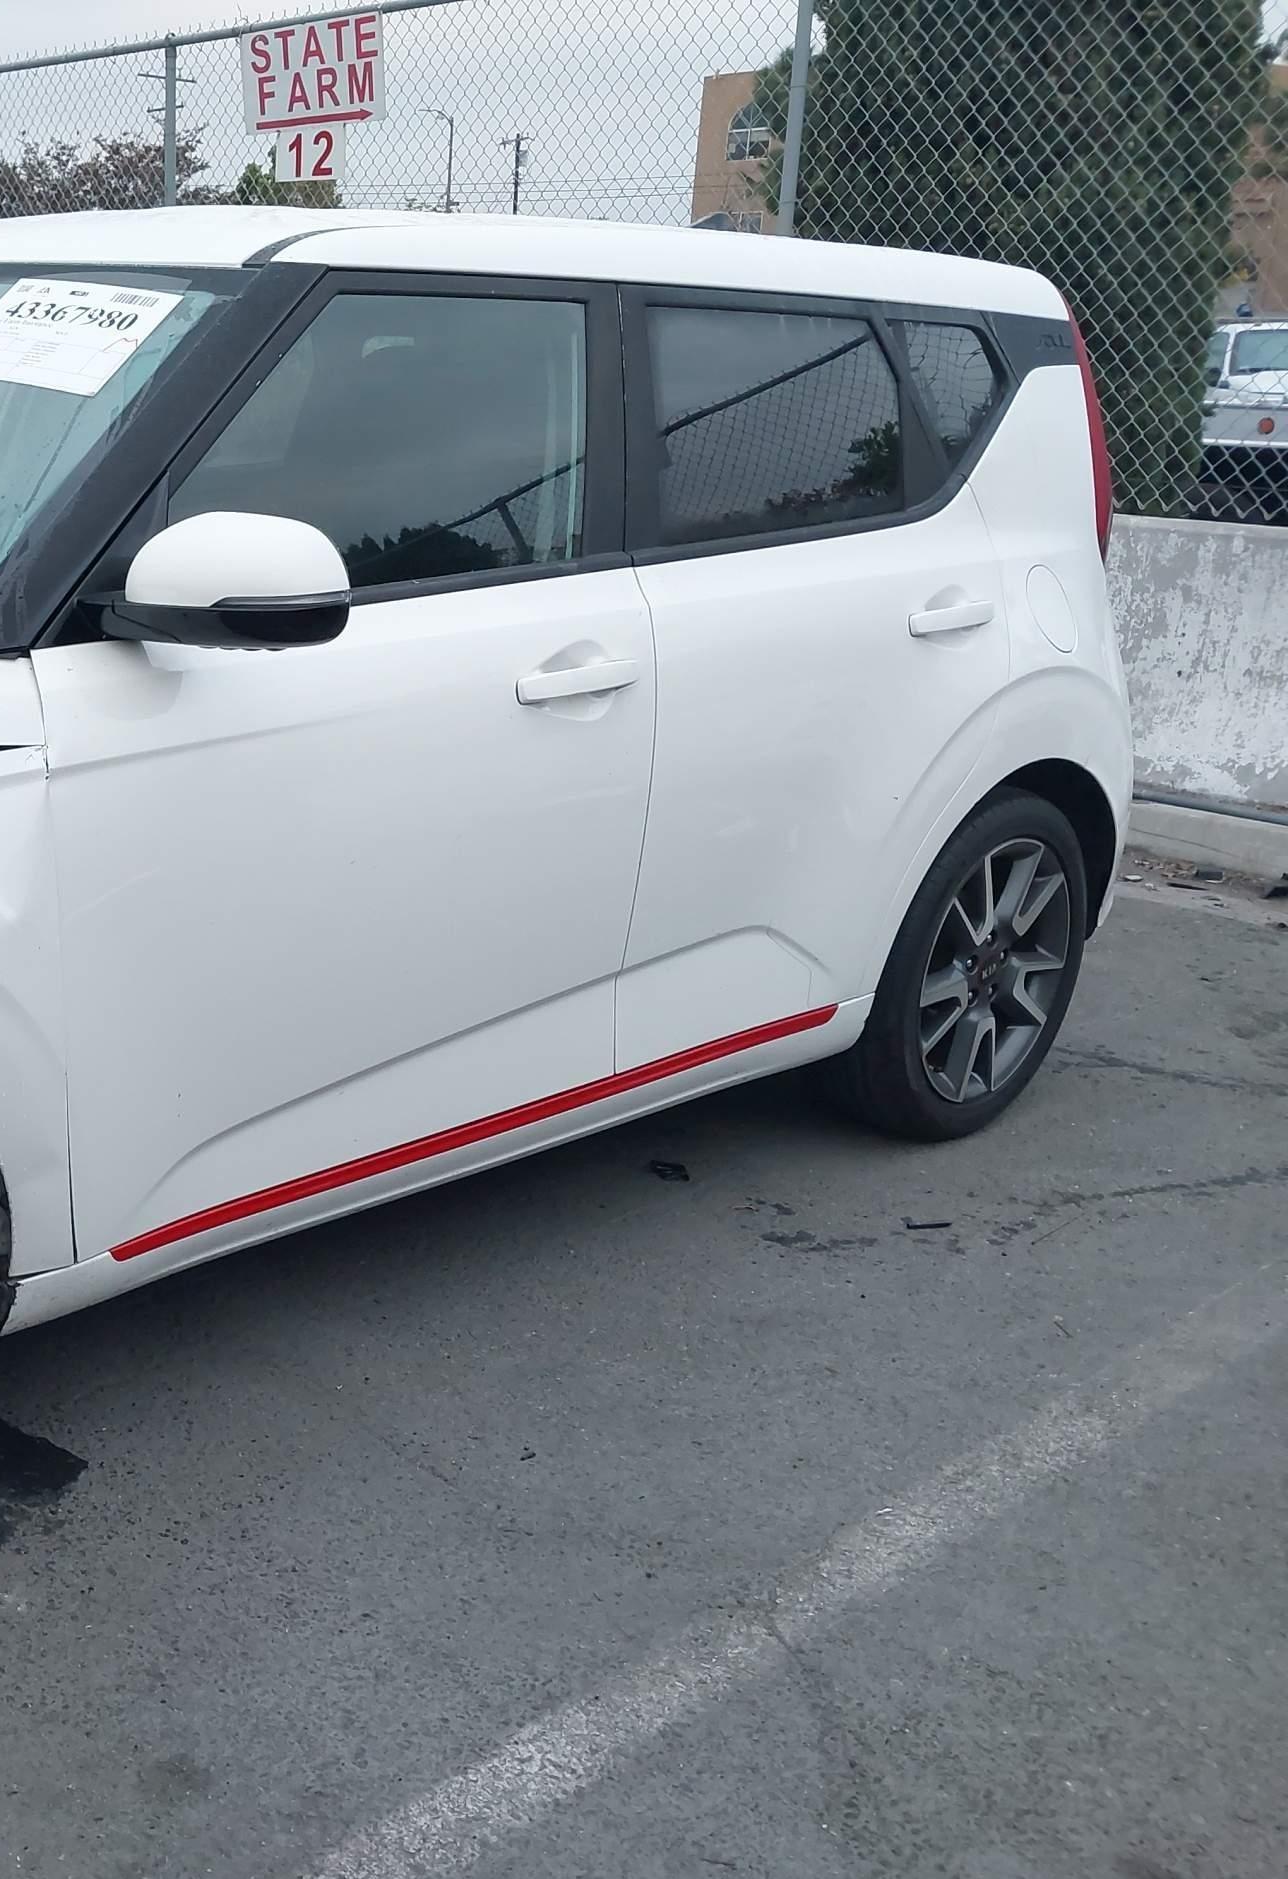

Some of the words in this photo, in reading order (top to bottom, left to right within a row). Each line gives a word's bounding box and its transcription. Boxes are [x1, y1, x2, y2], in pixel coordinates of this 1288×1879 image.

[250, 15, 378, 74] STATE
[257, 61, 375, 116] FARM
[288, 130, 334, 178] 12
[5, 300, 139, 331] 43367980
